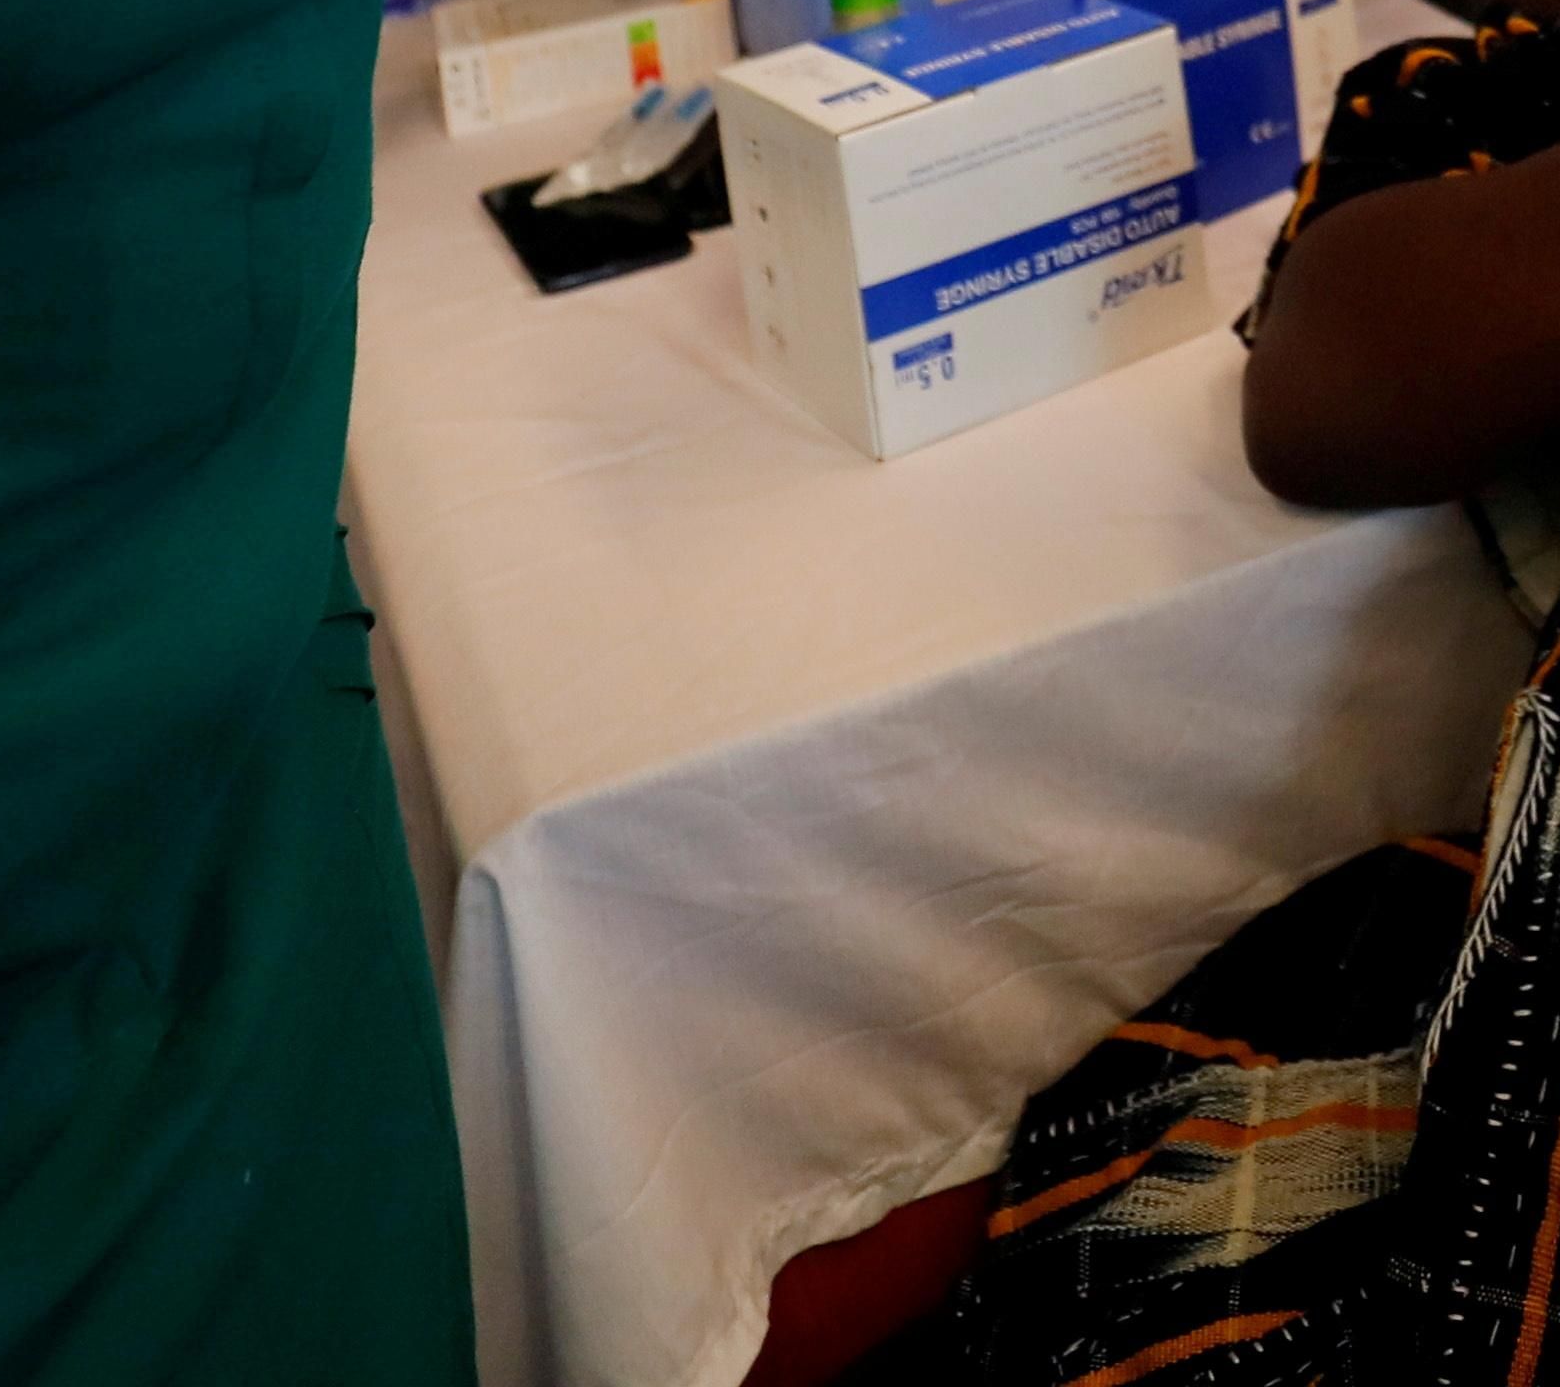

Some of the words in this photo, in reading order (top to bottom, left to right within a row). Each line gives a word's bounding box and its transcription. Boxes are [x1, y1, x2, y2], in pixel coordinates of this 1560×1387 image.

[1125, 203, 1182, 242] AUTO
[1034, 228, 1123, 271] DISABLE
[935, 257, 1033, 311] SYRINGE
